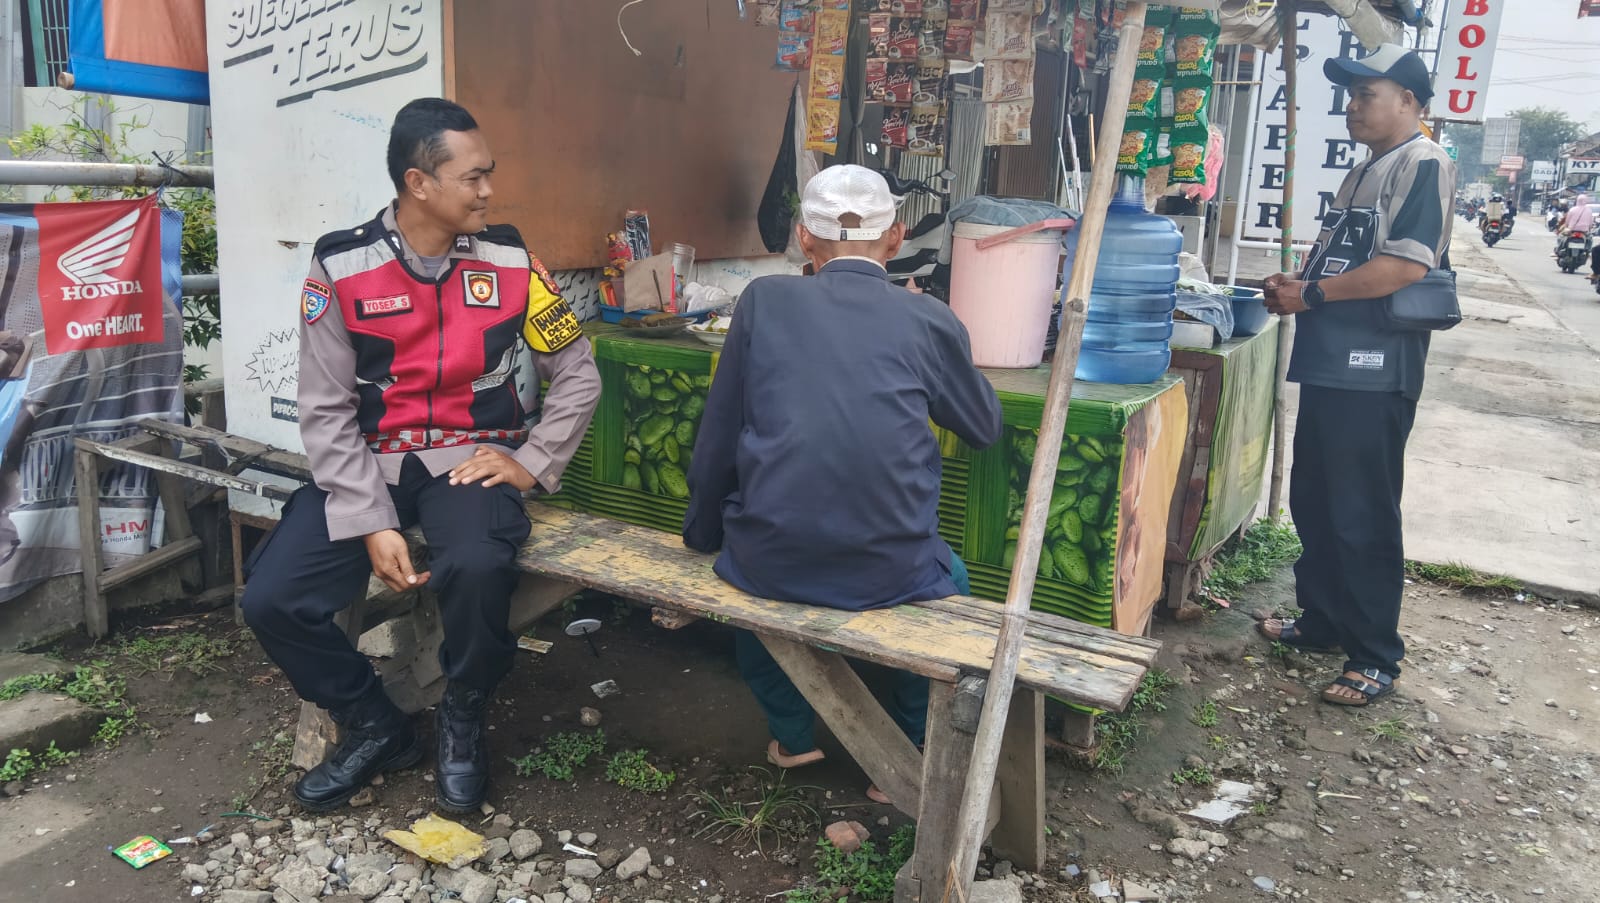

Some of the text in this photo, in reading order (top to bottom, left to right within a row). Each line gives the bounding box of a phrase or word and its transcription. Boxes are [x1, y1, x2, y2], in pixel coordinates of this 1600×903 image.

[273, 1, 424, 87] TERUS
[1448, 0, 1489, 114] BOLU
[60, 280, 144, 301] HONDA
[401, 298, 408, 307] S
[66, 313, 145, 340] One HEART.
[100, 519, 148, 537] HM
